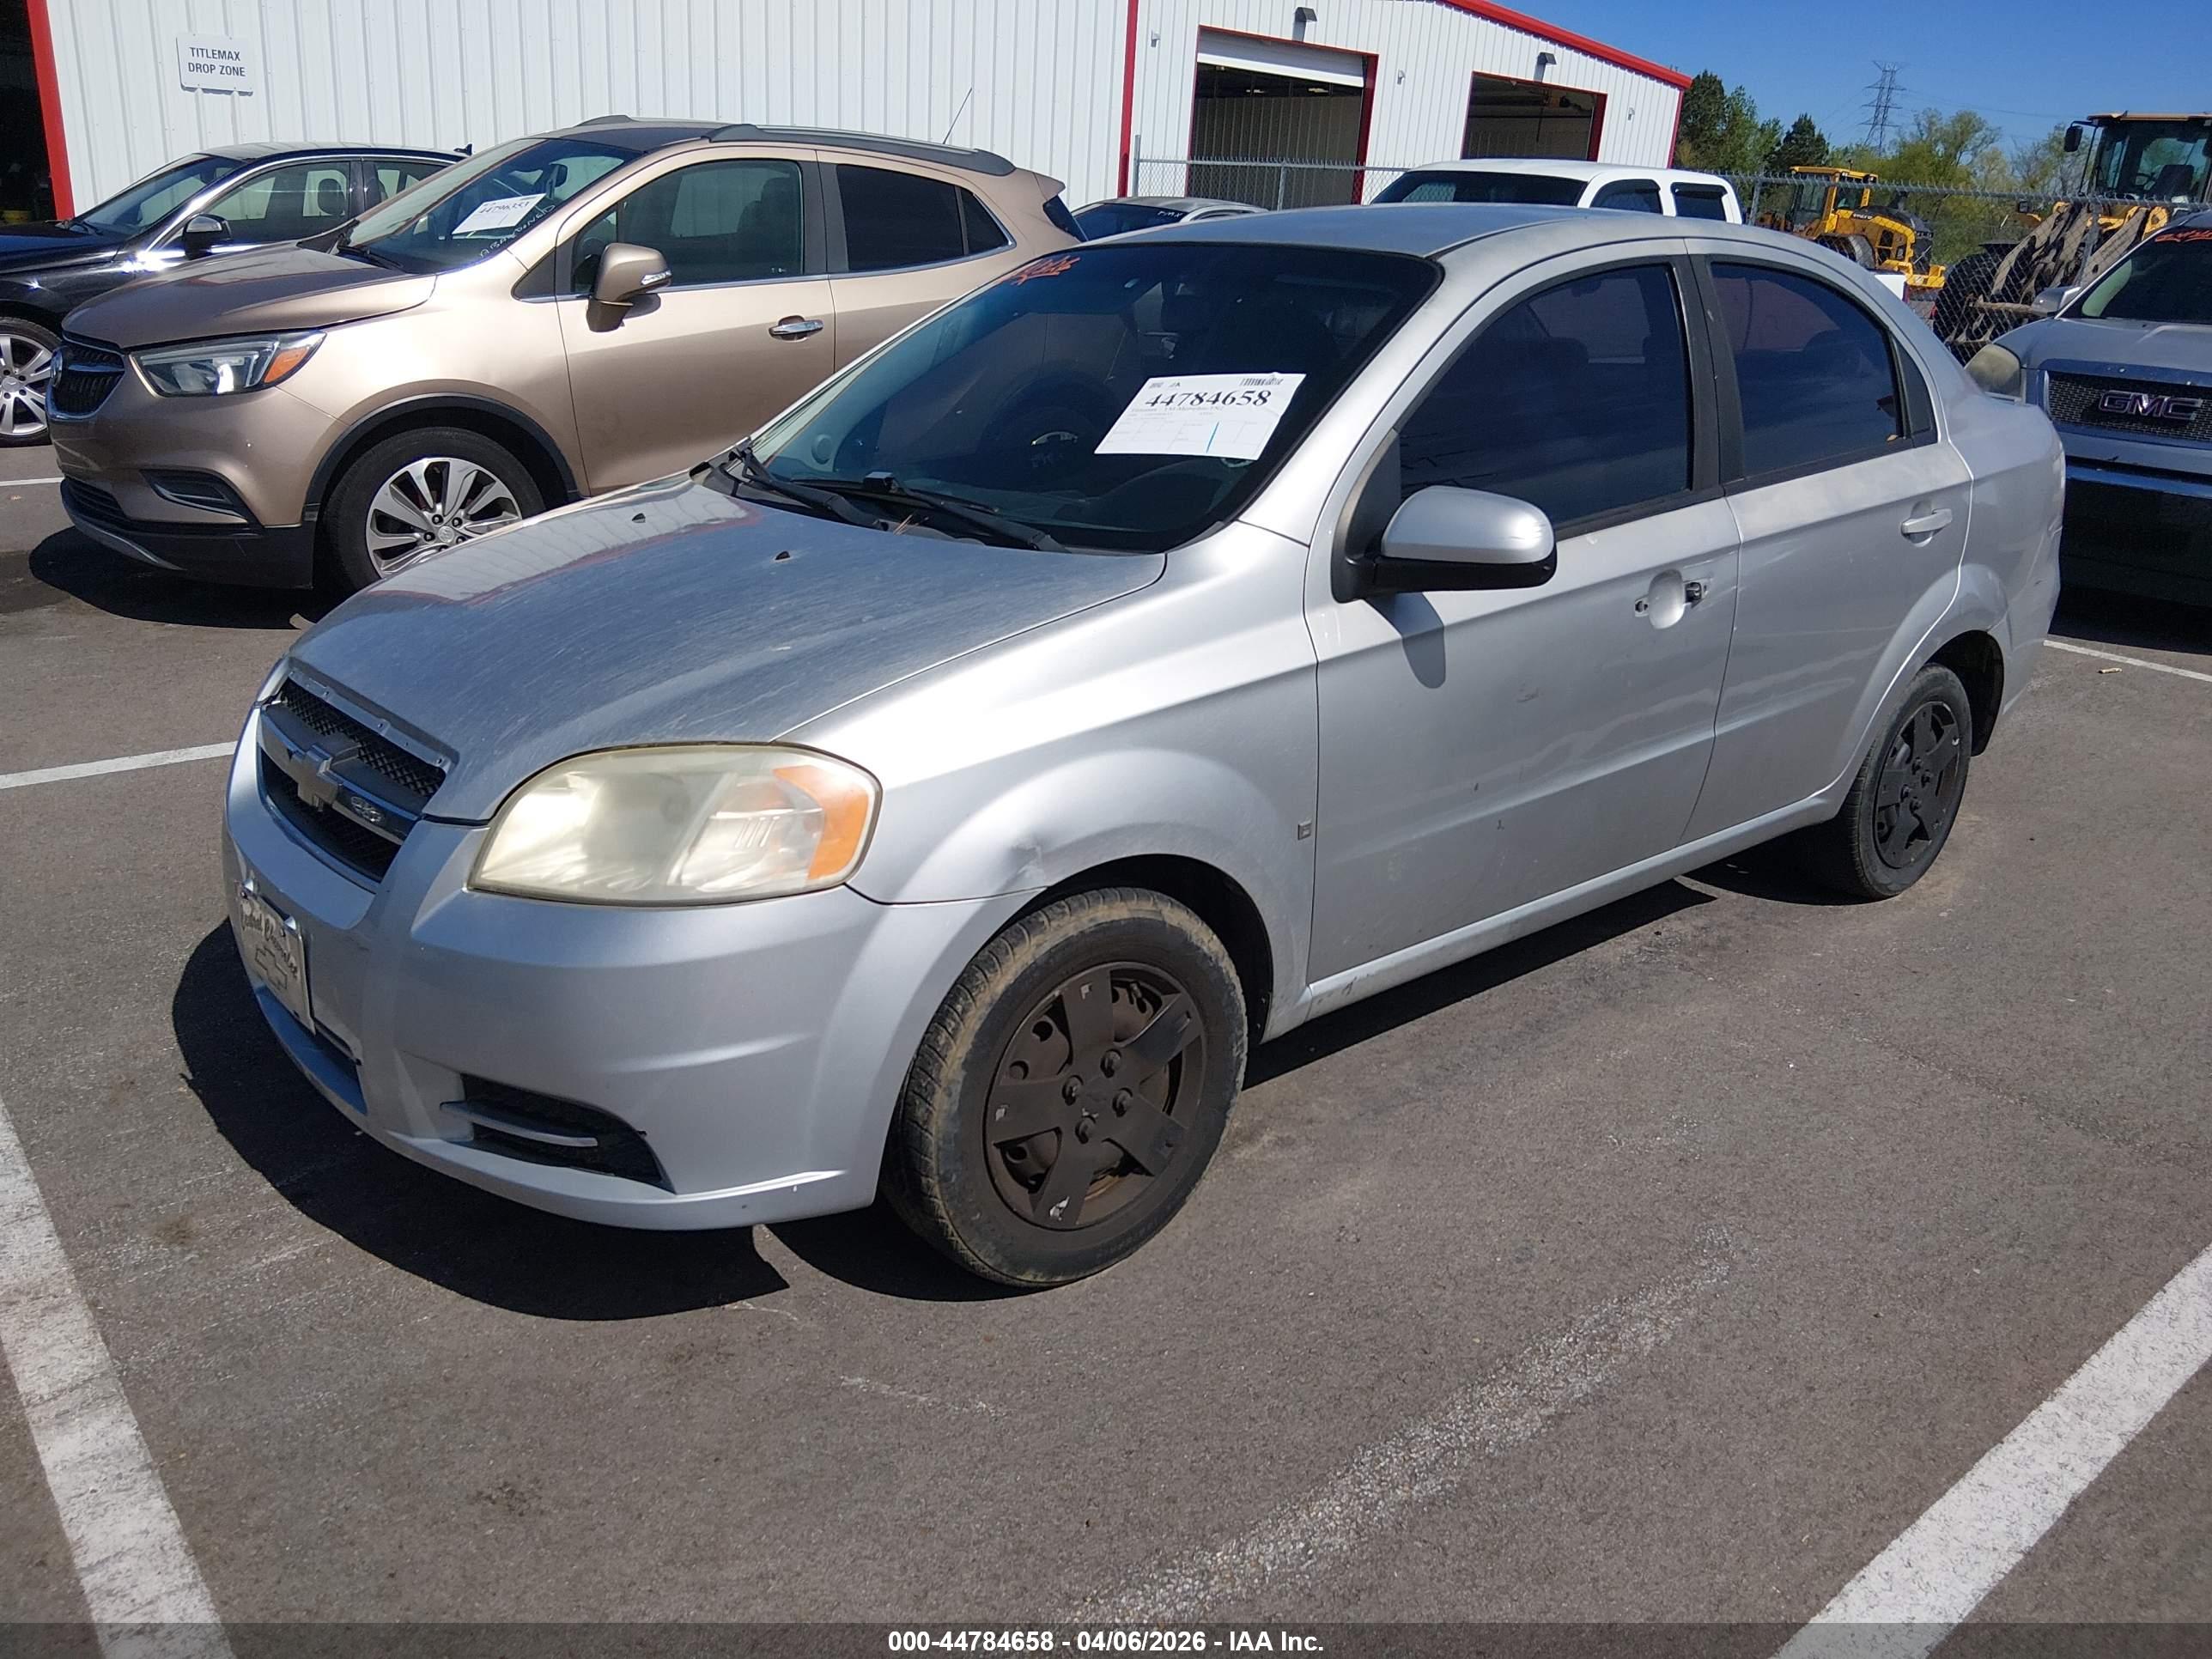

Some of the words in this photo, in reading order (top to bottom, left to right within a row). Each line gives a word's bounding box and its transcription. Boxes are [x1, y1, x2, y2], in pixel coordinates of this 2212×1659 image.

[189, 46, 241, 62] TITLEMAX
[188, 62, 216, 74] DROP
[219, 64, 246, 77] ZONE
[1146, 389, 1272, 407] 44784658
[2099, 389, 2203, 421] GMC
